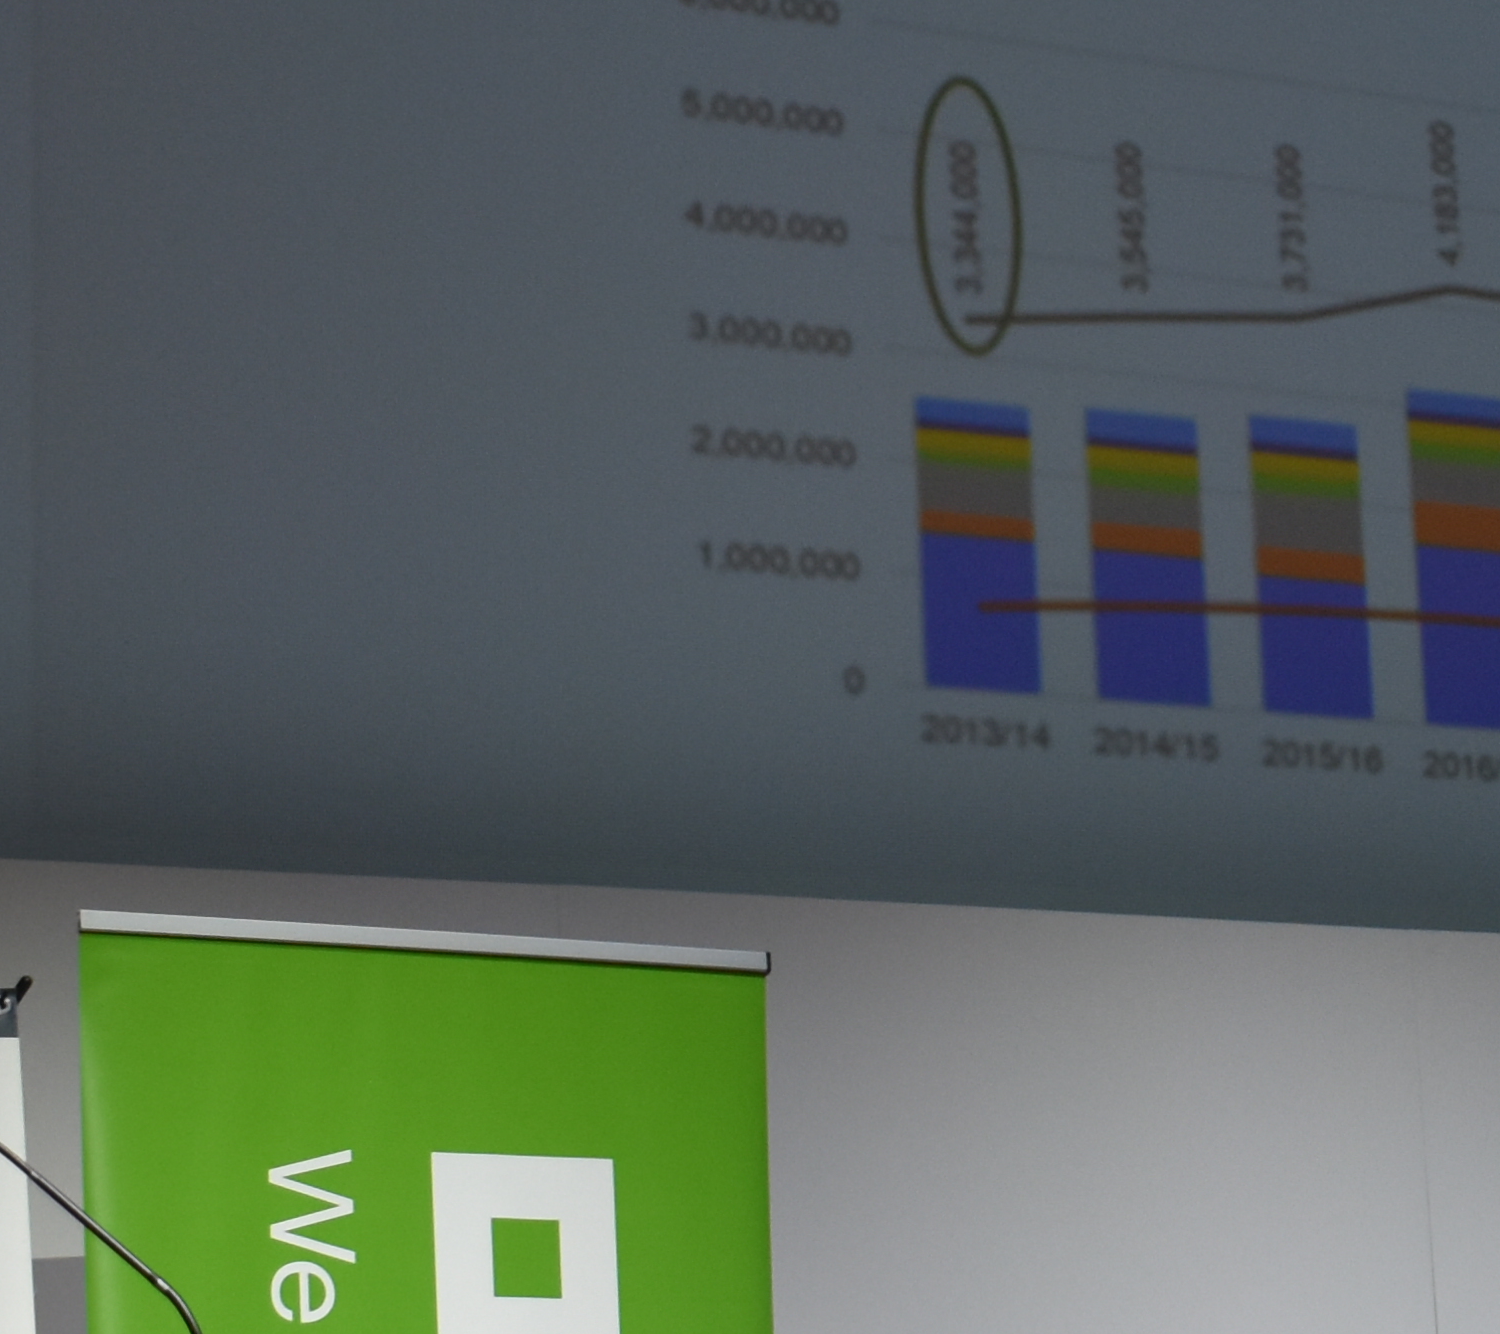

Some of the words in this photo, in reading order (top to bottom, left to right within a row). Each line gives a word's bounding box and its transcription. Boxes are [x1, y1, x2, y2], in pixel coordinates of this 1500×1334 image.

[843, 667, 866, 695] 0
[920, 714, 1050, 749] 2013/14
[1094, 726, 1220, 762] 2014/15
[1261, 739, 1383, 773] 2015/16
[267, 1148, 356, 1324] We
